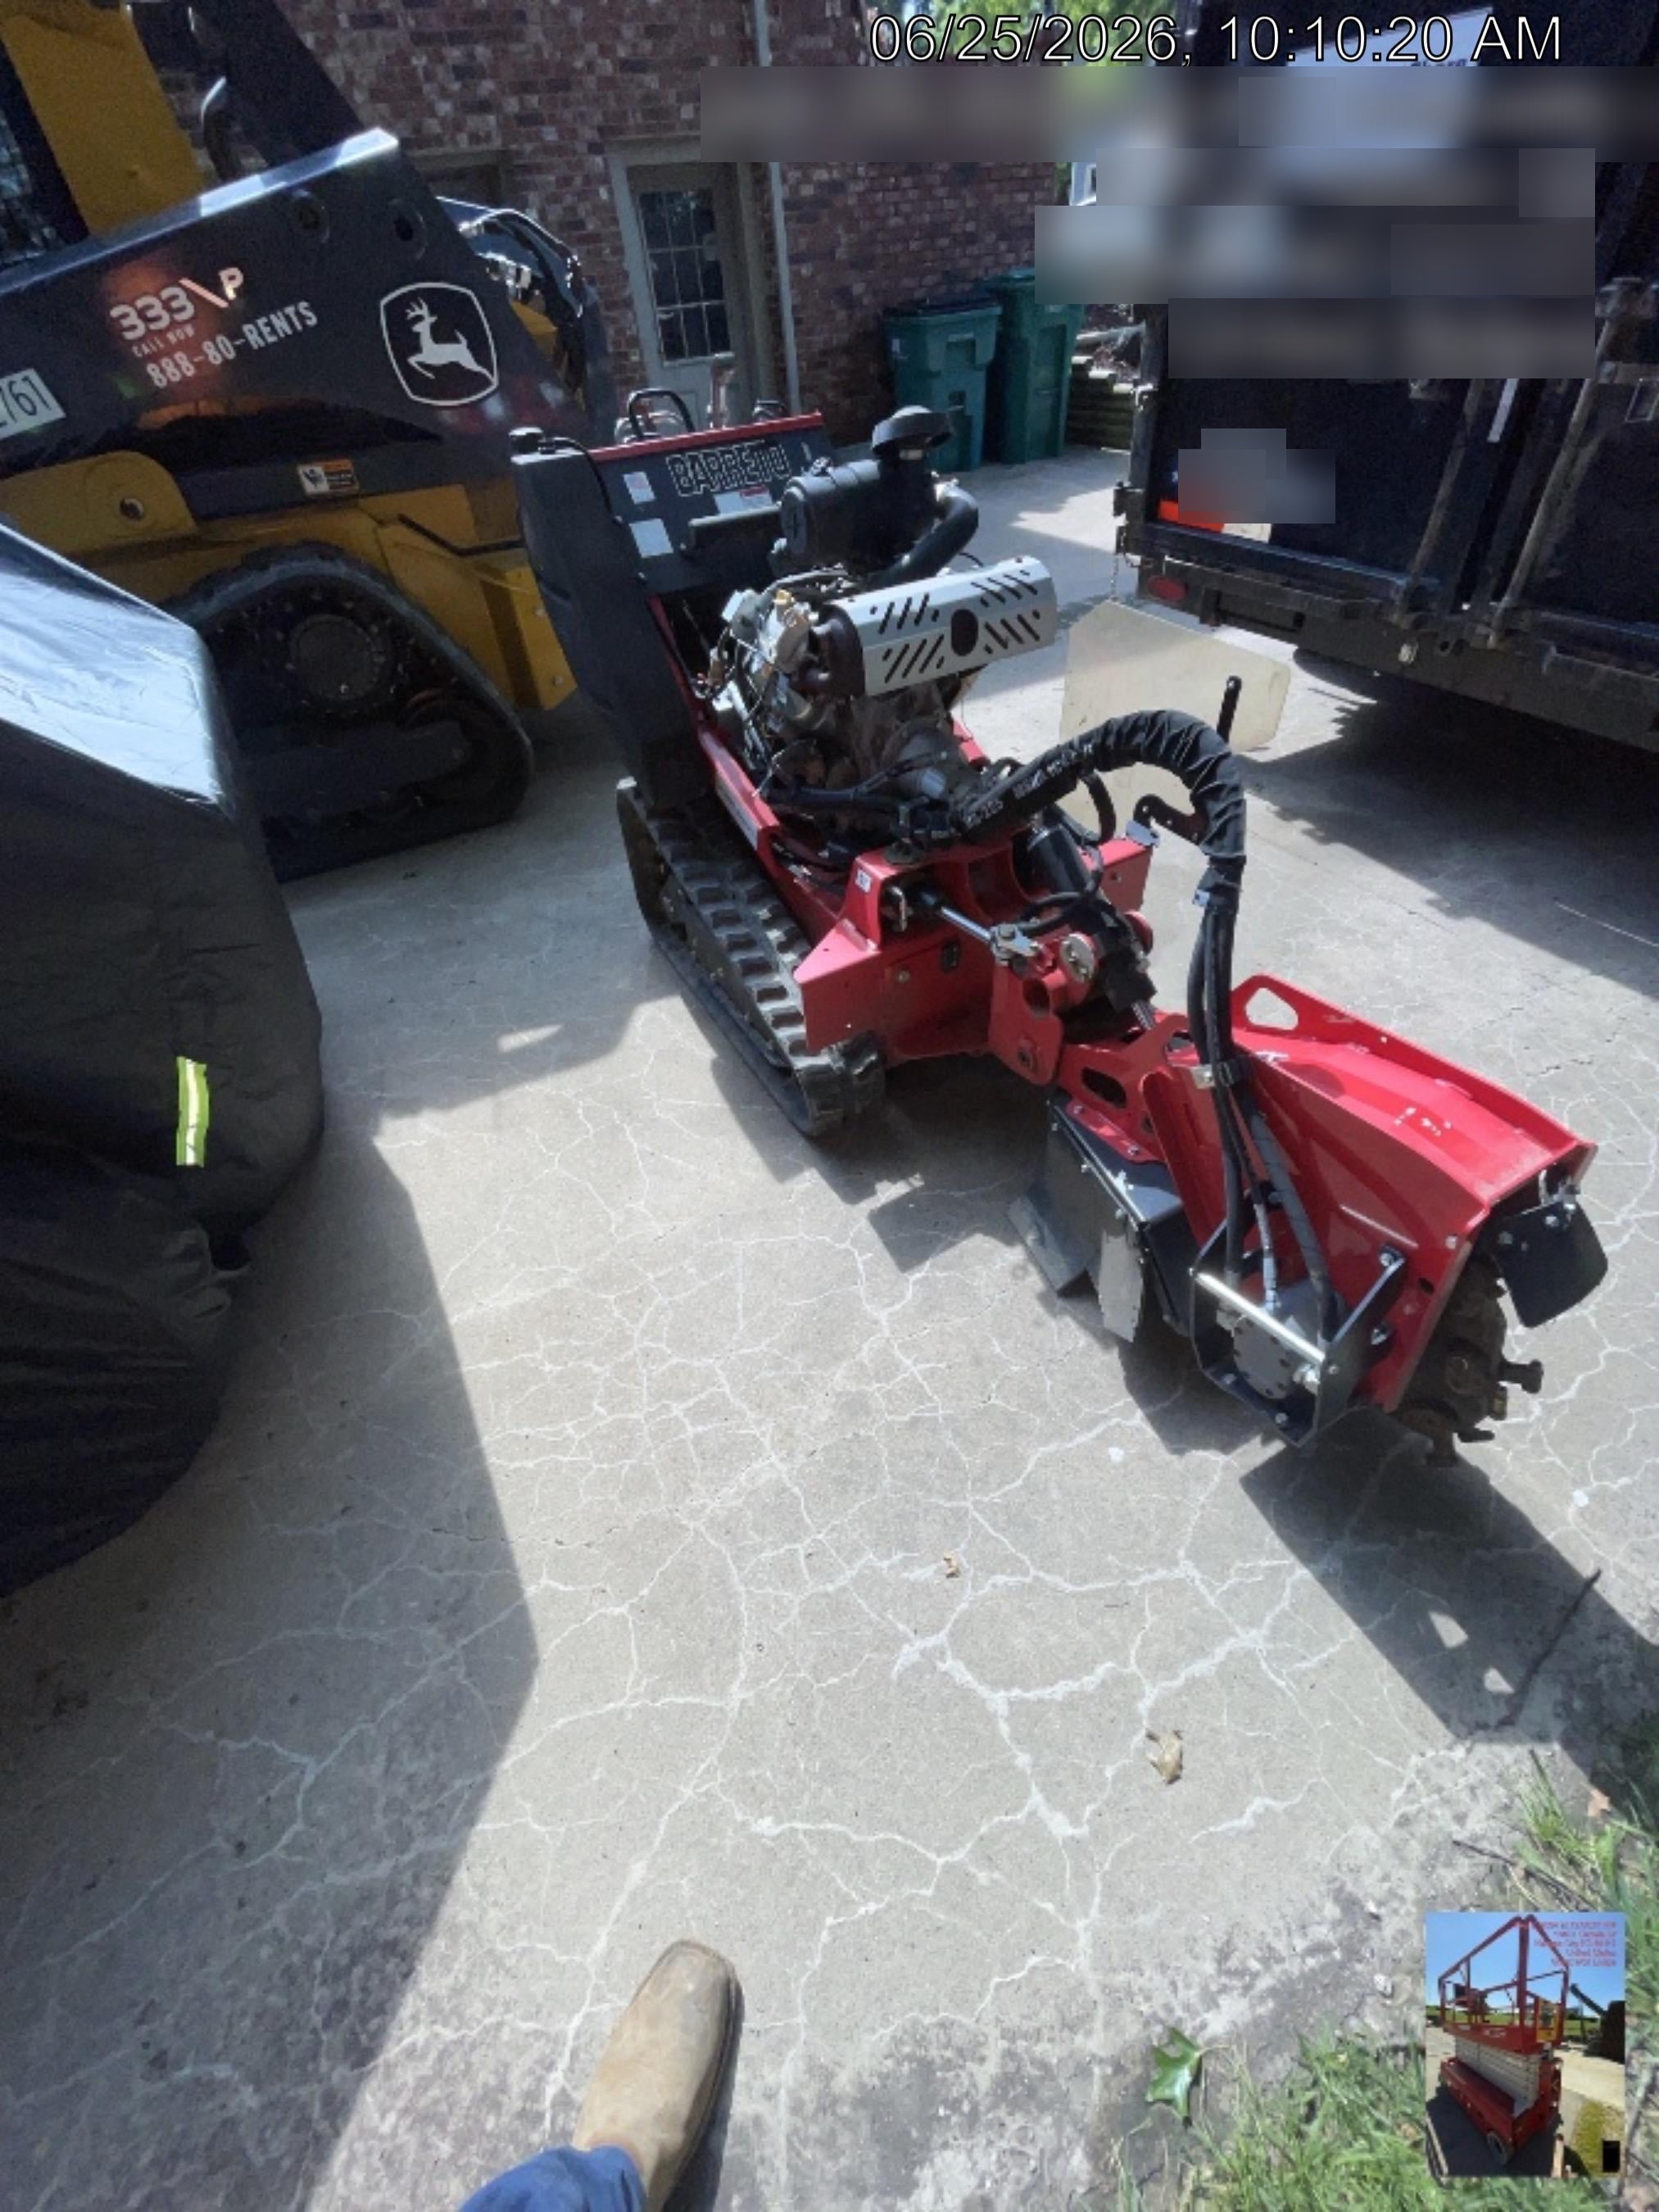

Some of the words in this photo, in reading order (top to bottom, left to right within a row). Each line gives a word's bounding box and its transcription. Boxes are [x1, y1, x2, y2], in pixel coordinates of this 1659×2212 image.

[132, 336, 165, 358] CALL
[166, 324, 195, 344] NOW
[146, 301, 318, 388] 888-80-RENTS
